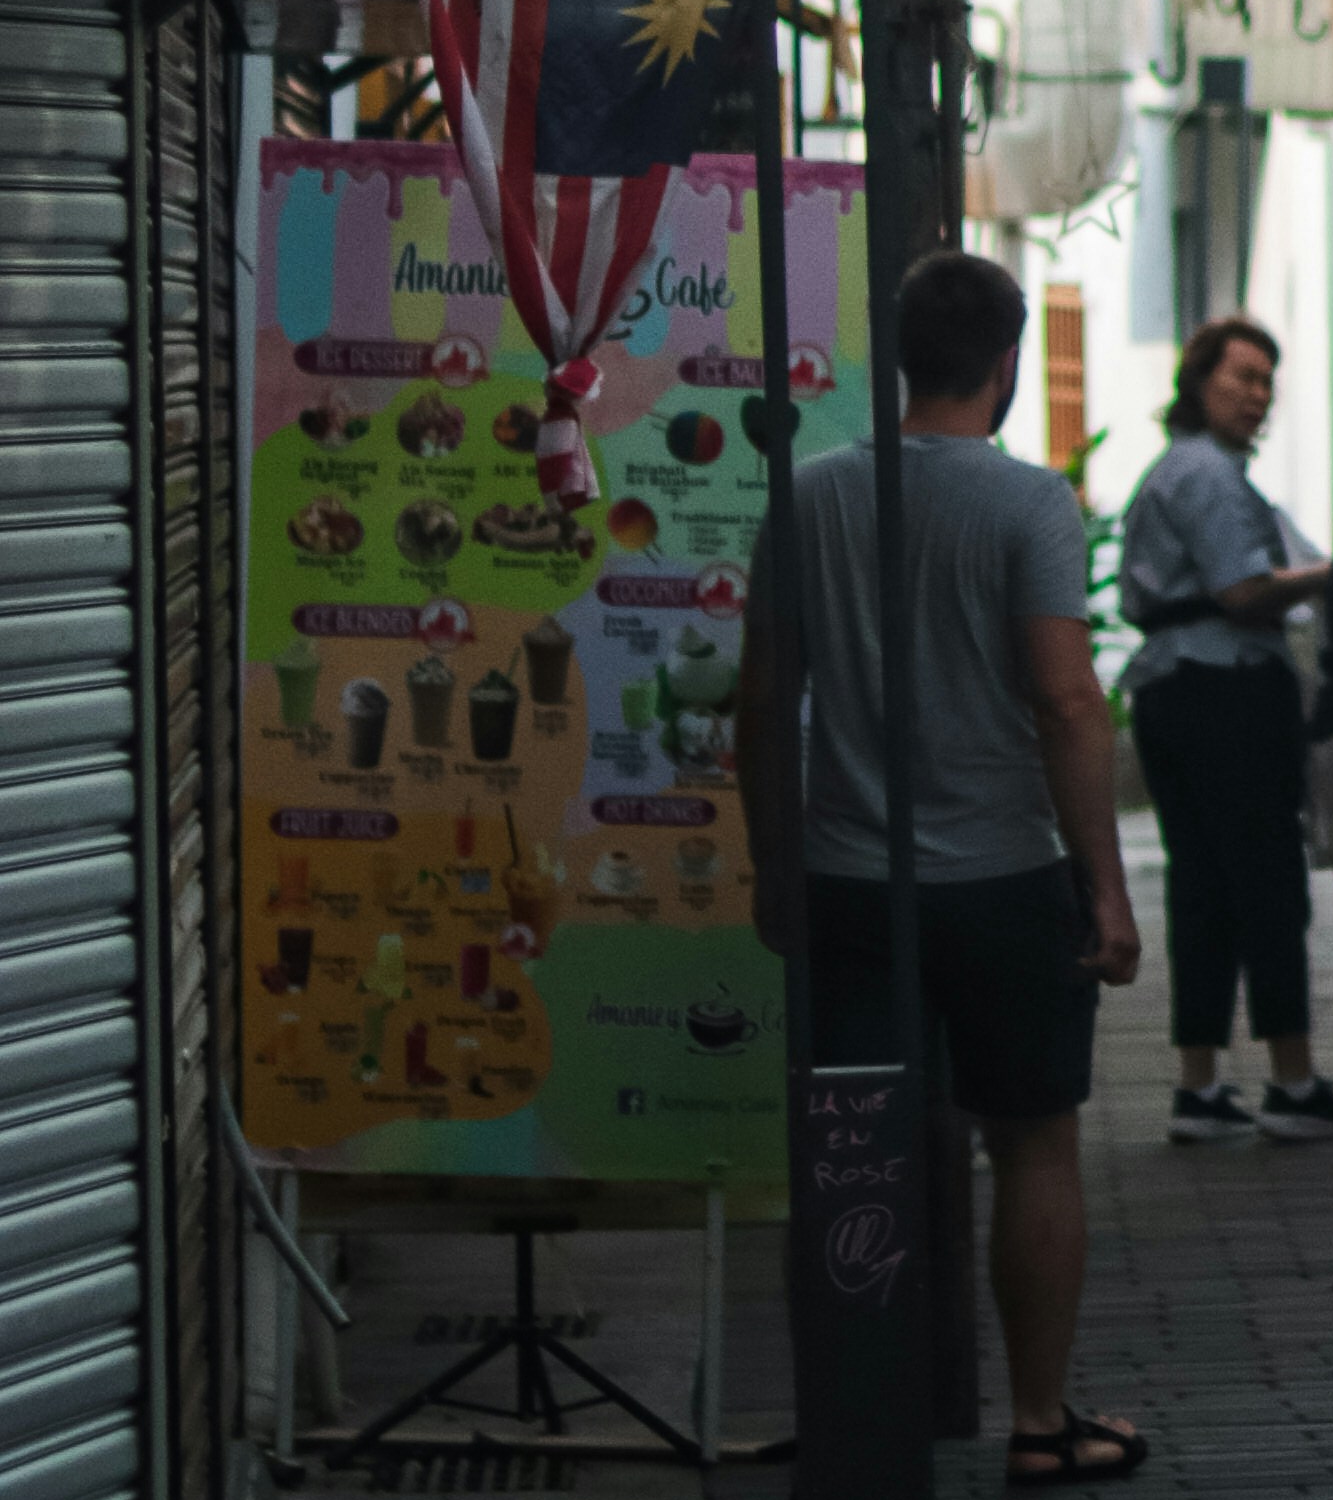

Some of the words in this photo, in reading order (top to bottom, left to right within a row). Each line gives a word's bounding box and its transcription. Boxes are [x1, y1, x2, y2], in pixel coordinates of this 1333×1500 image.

[656, 256, 736, 316] Café
[316, 346, 344, 370] ICE
[349, 346, 422, 372] DESSERT
[696, 360, 725, 384] ICE
[610, 580, 689, 604] COCONUT
[304, 608, 330, 632] ICE
[335, 608, 413, 634] BLENDED
[280, 810, 331, 835] FRUIT
[336, 811, 388, 837] JUICE
[604, 801, 639, 821] HOT
[808, 1090, 841, 1116] LA
[848, 1086, 895, 1116] VIE
[826, 1128, 873, 1151] EN
